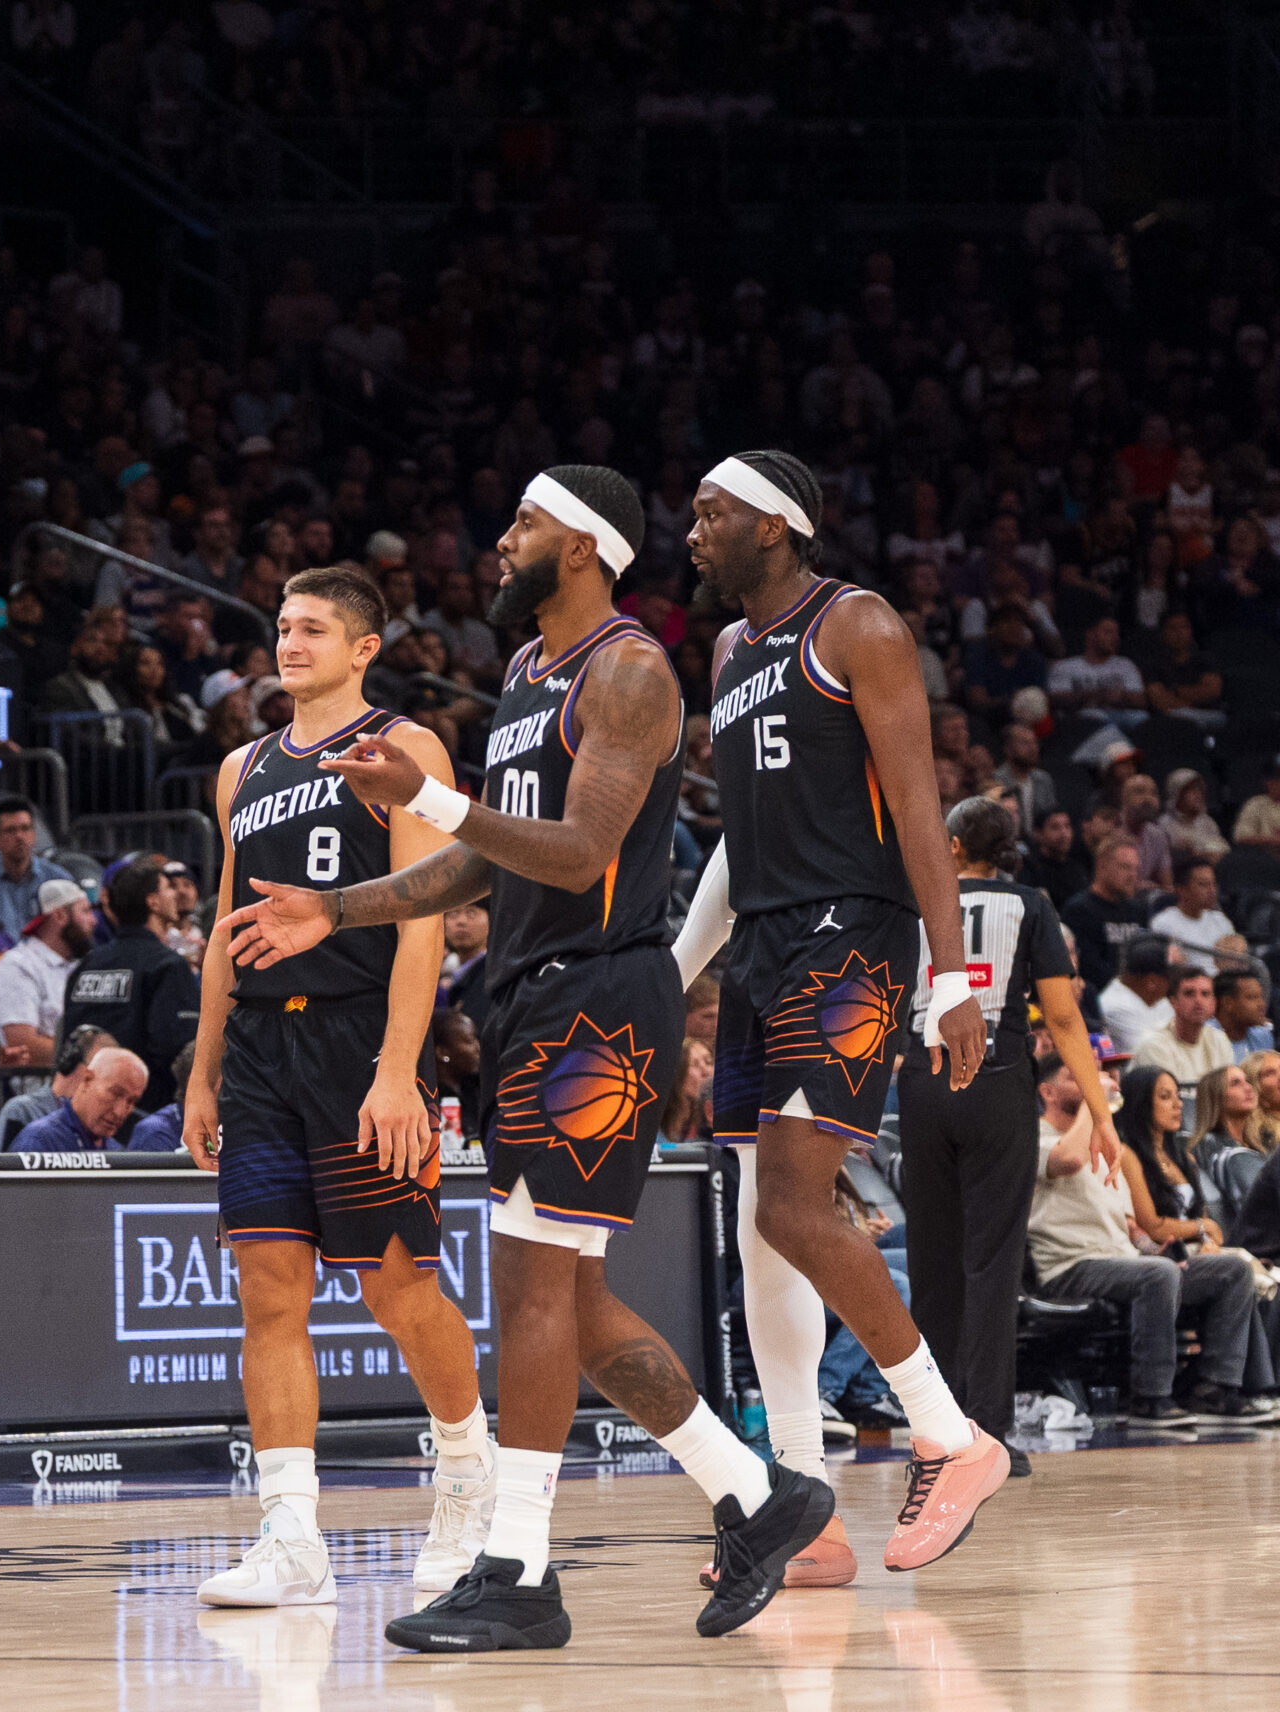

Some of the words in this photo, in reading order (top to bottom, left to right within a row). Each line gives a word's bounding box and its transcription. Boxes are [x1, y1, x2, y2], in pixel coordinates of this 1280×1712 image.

[766, 633, 798, 647] PayPal
[545, 675, 572, 692] PayPal
[710, 656, 791, 743] PHOENIX
[486, 707, 556, 771] HOENIX
[753, 714, 791, 771] 15
[230, 774, 345, 851] PHOENIX
[501, 768, 539, 820] 00
[306, 826, 341, 881] 8
[43, 1152, 111, 1169] FANDUEL
[129, 1354, 227, 1384] PREMIUM
[363, 1348, 389, 1376] ON
[55, 1453, 122, 1473] FANDUEL
